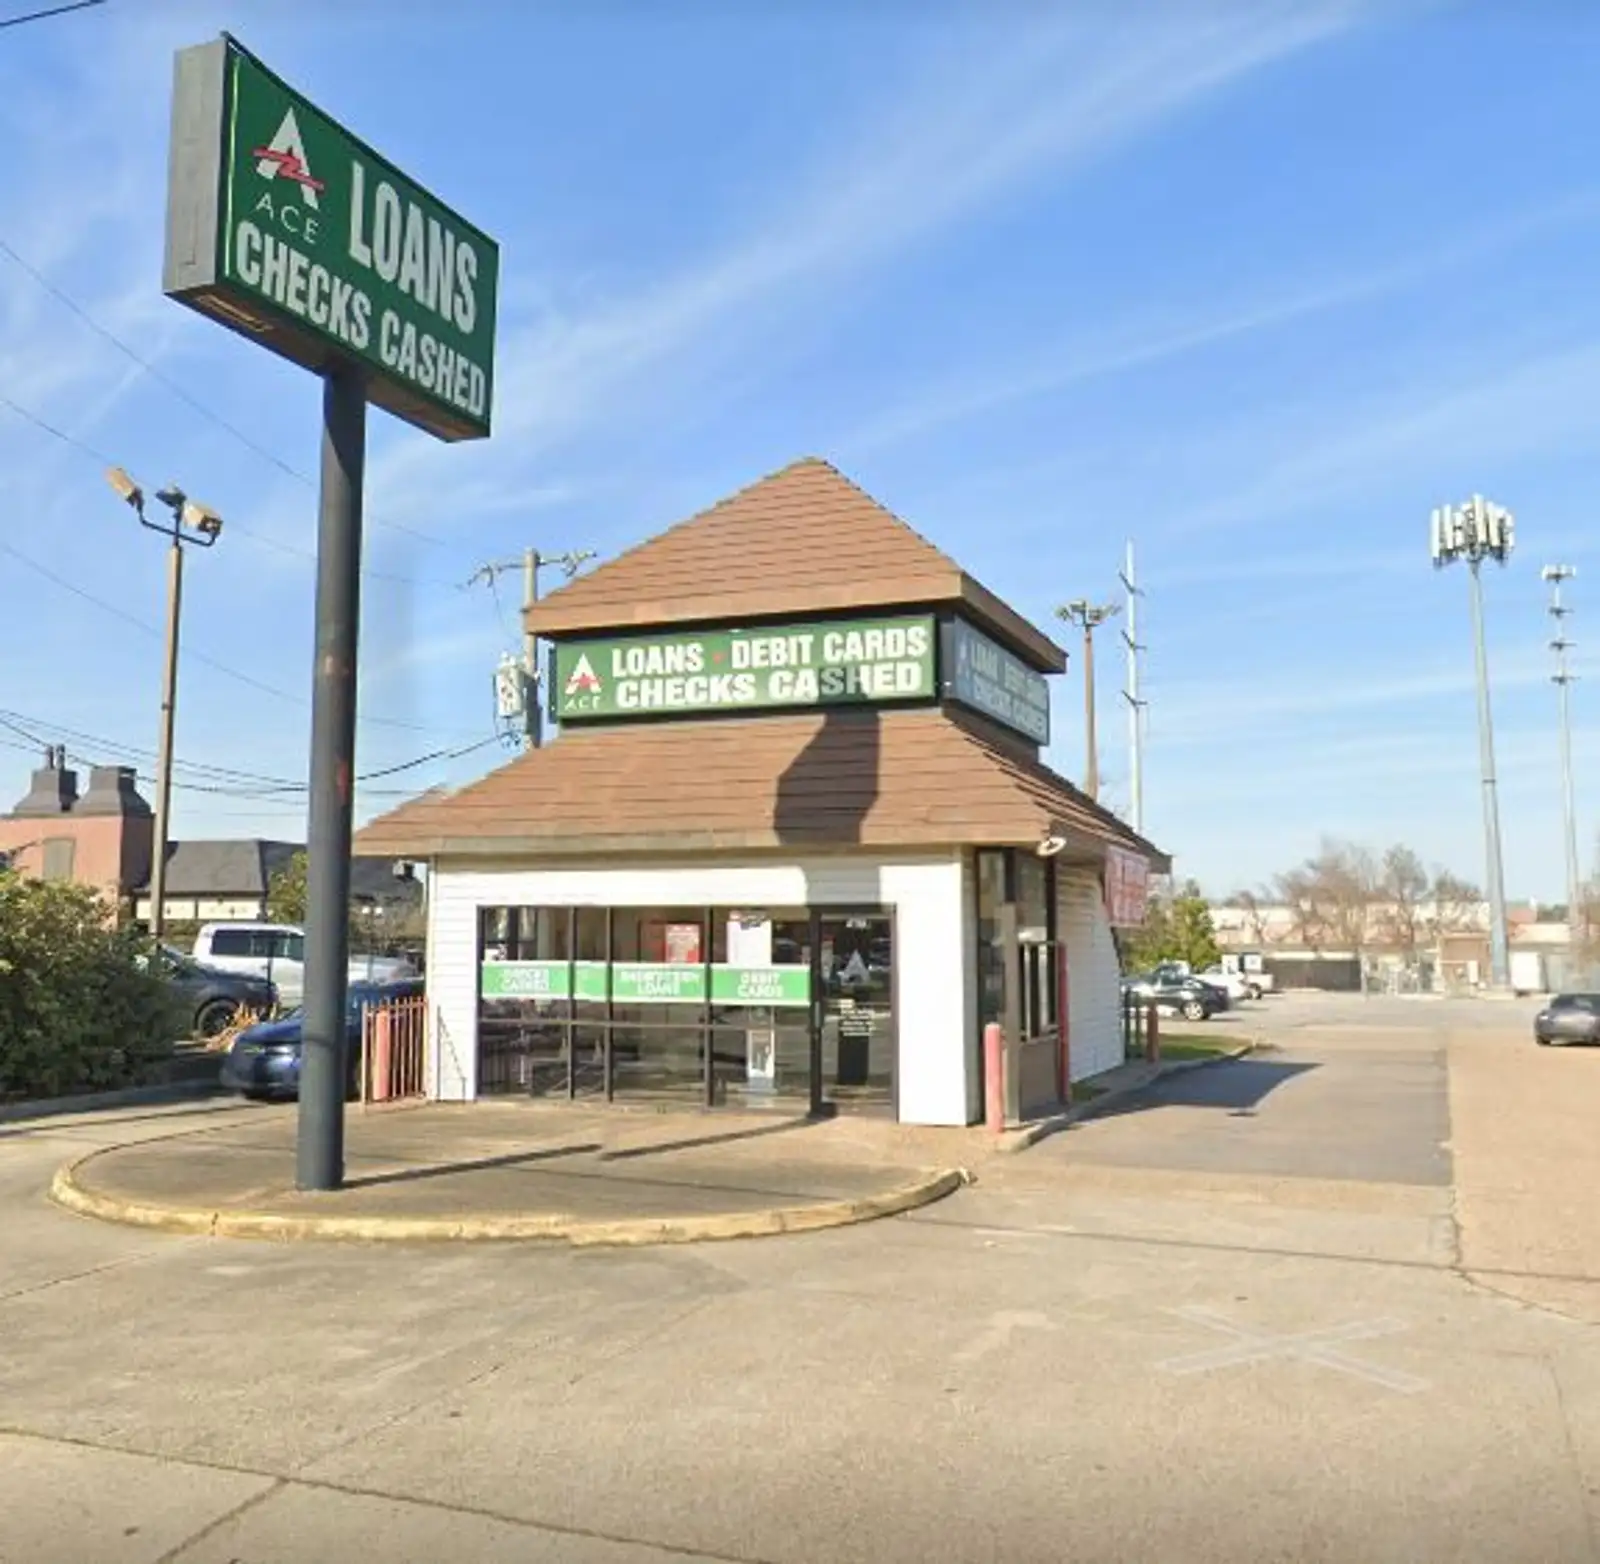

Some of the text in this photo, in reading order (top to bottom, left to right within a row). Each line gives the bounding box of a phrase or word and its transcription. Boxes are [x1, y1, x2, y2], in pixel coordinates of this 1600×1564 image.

[255, 192, 319, 245] ACE
[348, 160, 478, 335] LOANS
[236, 220, 486, 416] CHECKS CASHED
[611, 642, 704, 677] LOANS
[731, 633, 815, 669] DEBIT
[823, 625, 928, 662] CARDS
[615, 660, 923, 708] CHECKS CASHED
